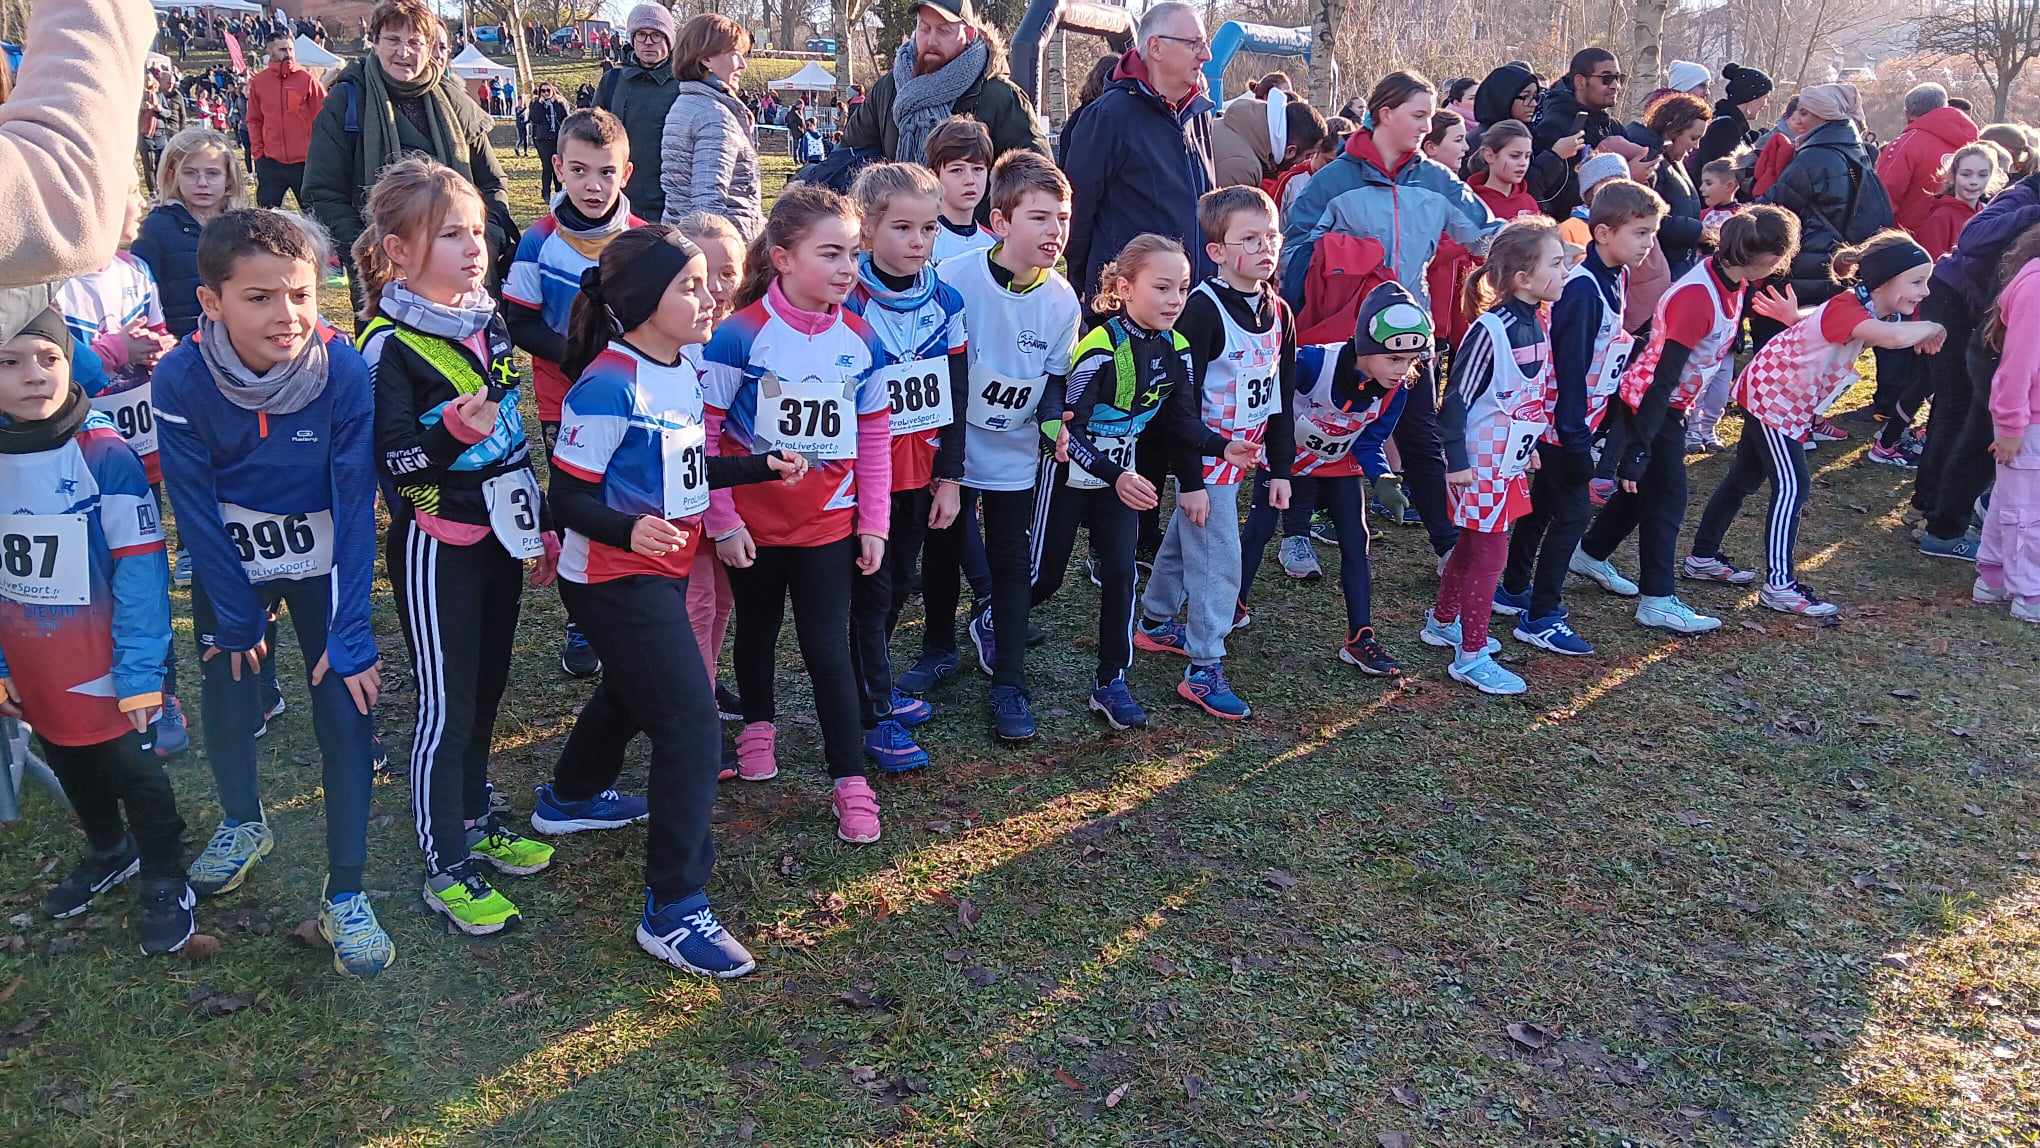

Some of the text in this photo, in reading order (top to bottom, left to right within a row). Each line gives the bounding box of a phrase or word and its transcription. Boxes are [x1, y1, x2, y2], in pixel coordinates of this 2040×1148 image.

[887, 373, 940, 414] 388
[981, 381, 1032, 410] 448
[103, 400, 152, 439] 90
[778, 398, 840, 437] 376
[1306, 434, 1351, 455] 341
[1516, 433, 1535, 460] 3
[682, 444, 709, 490] 37
[0, 533, 59, 579] 87
[225, 511, 315, 562] 396
